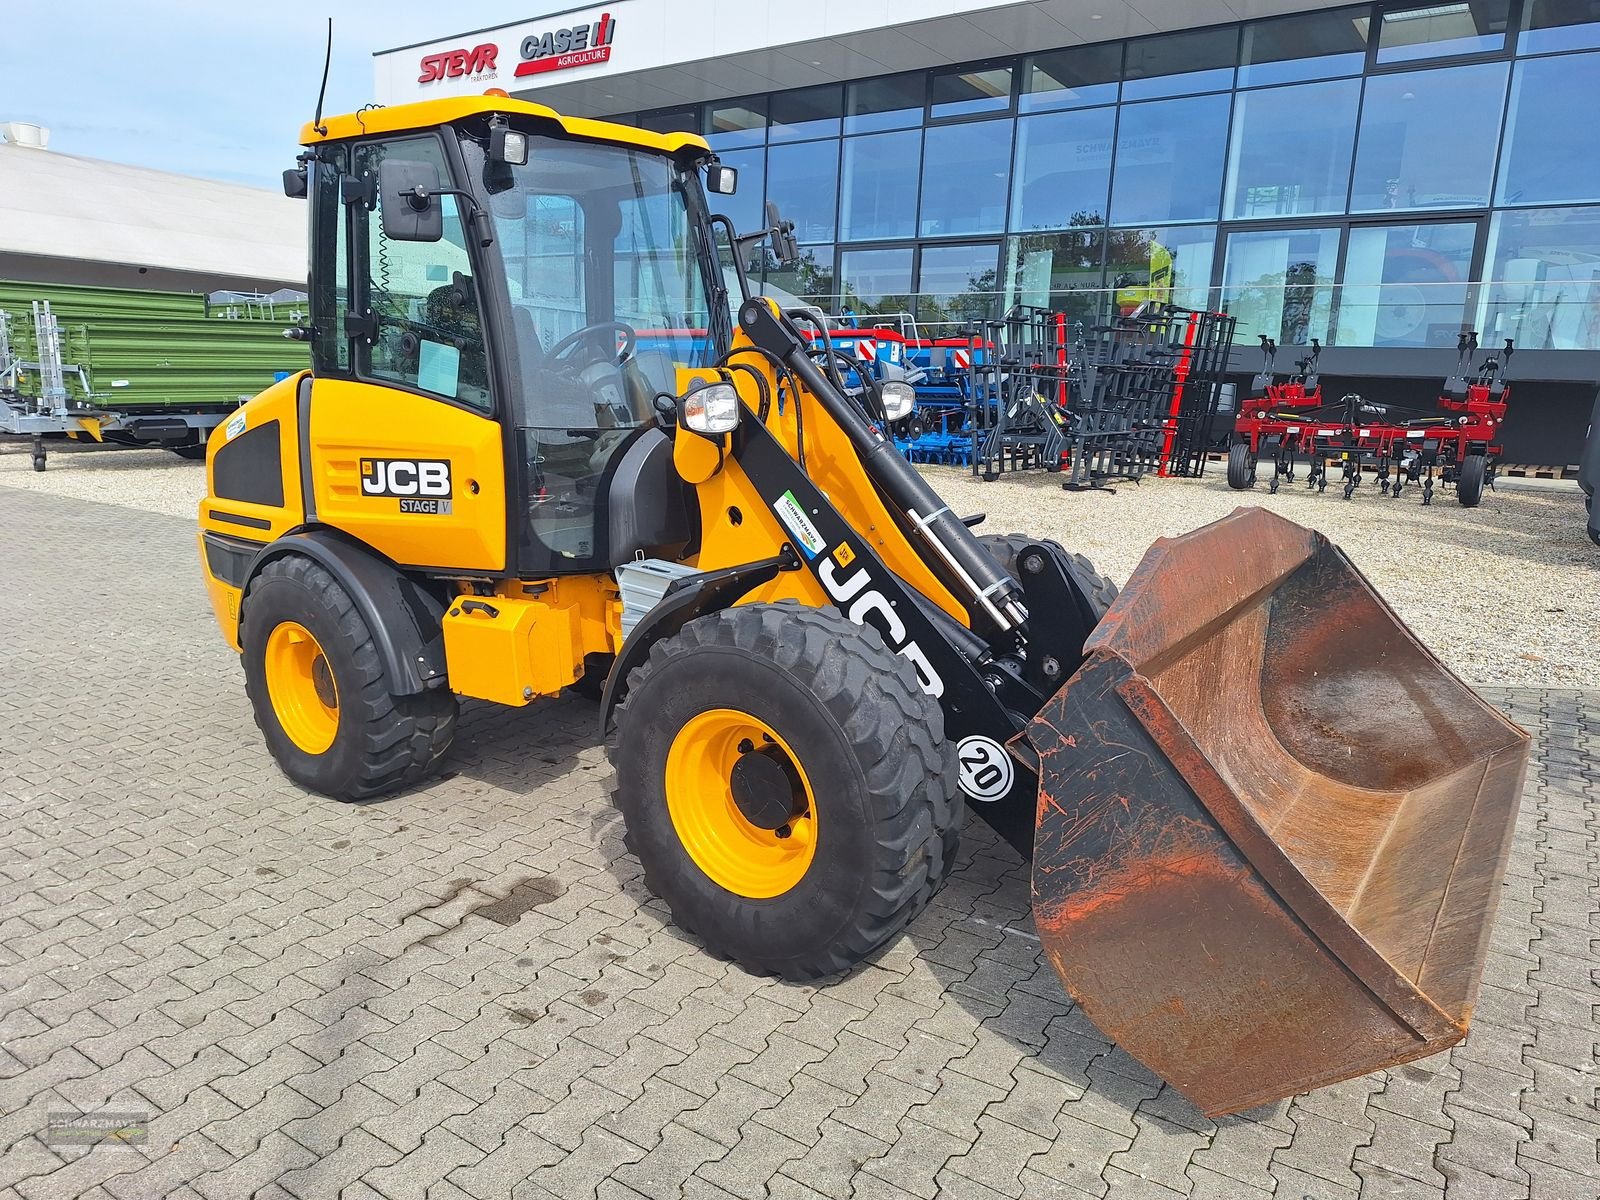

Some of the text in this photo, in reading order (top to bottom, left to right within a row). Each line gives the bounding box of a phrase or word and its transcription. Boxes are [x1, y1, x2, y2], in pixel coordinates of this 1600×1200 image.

[520, 23, 590, 60] CASE
[557, 49, 606, 67] AGRICULTURE
[417, 43, 499, 83] STEYR
[1075, 138, 1160, 154] SCHWAZMAYR
[362, 461, 451, 496] JCB
[401, 500, 450, 513] STAGE V
[785, 499, 817, 543] SCHWARZMAYR
[960, 747, 1003, 790] 20
